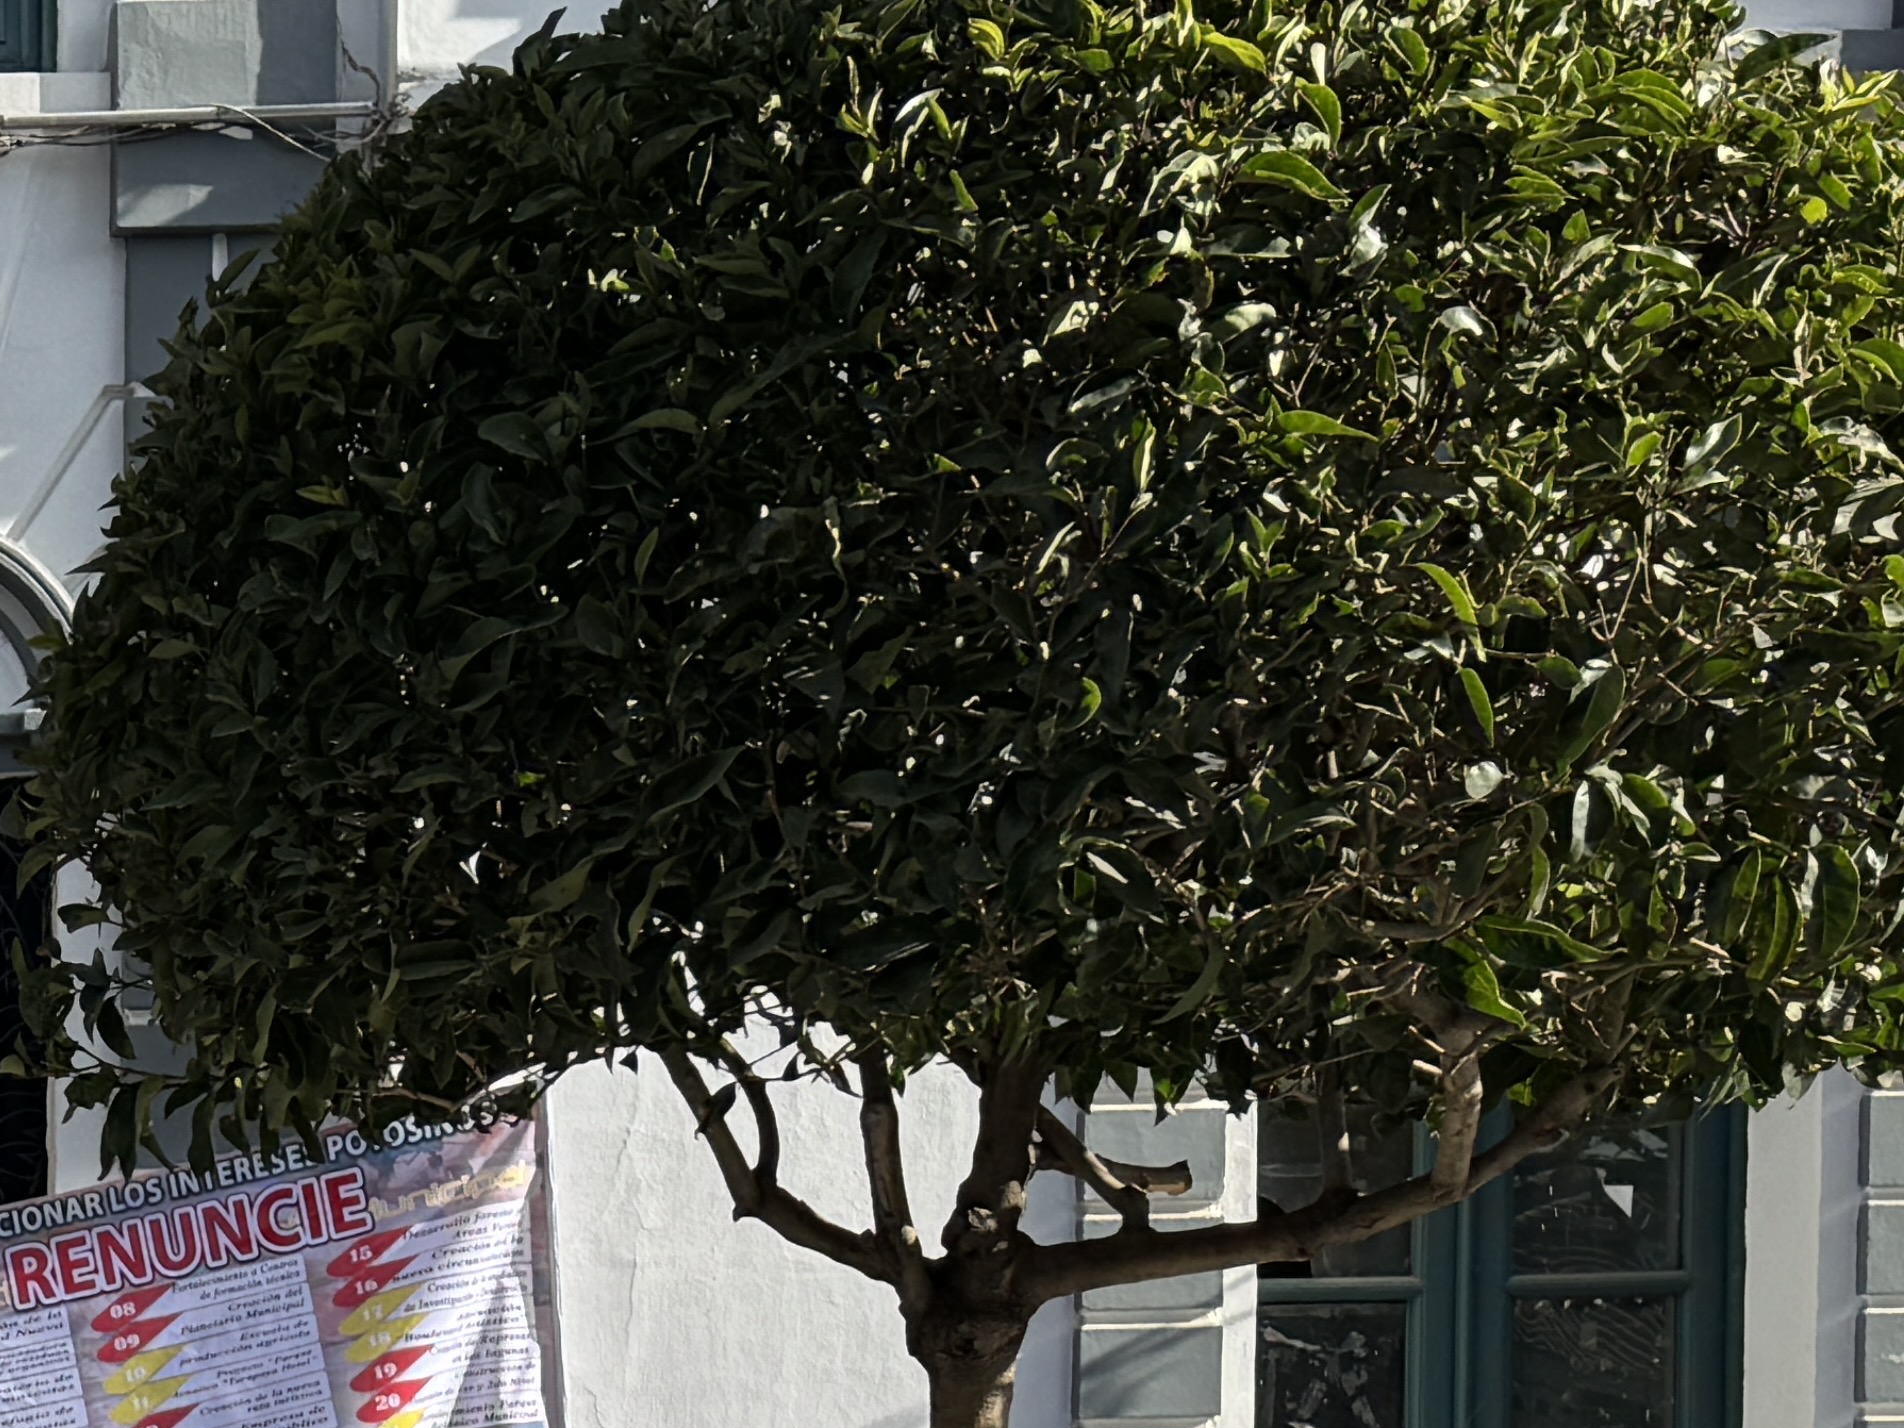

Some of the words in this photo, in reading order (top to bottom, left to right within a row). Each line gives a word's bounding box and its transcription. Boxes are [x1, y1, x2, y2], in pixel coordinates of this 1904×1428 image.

[107, 1176, 163, 1210] LOS
[4, 1167, 376, 1312] RENUNCIE
[349, 1245, 373, 1262] 15
[355, 1278, 379, 1295] 16
[109, 1301, 137, 1319] 08
[113, 1333, 141, 1350] 09
[373, 1361, 398, 1379] 19
[374, 1392, 401, 1411] 20
